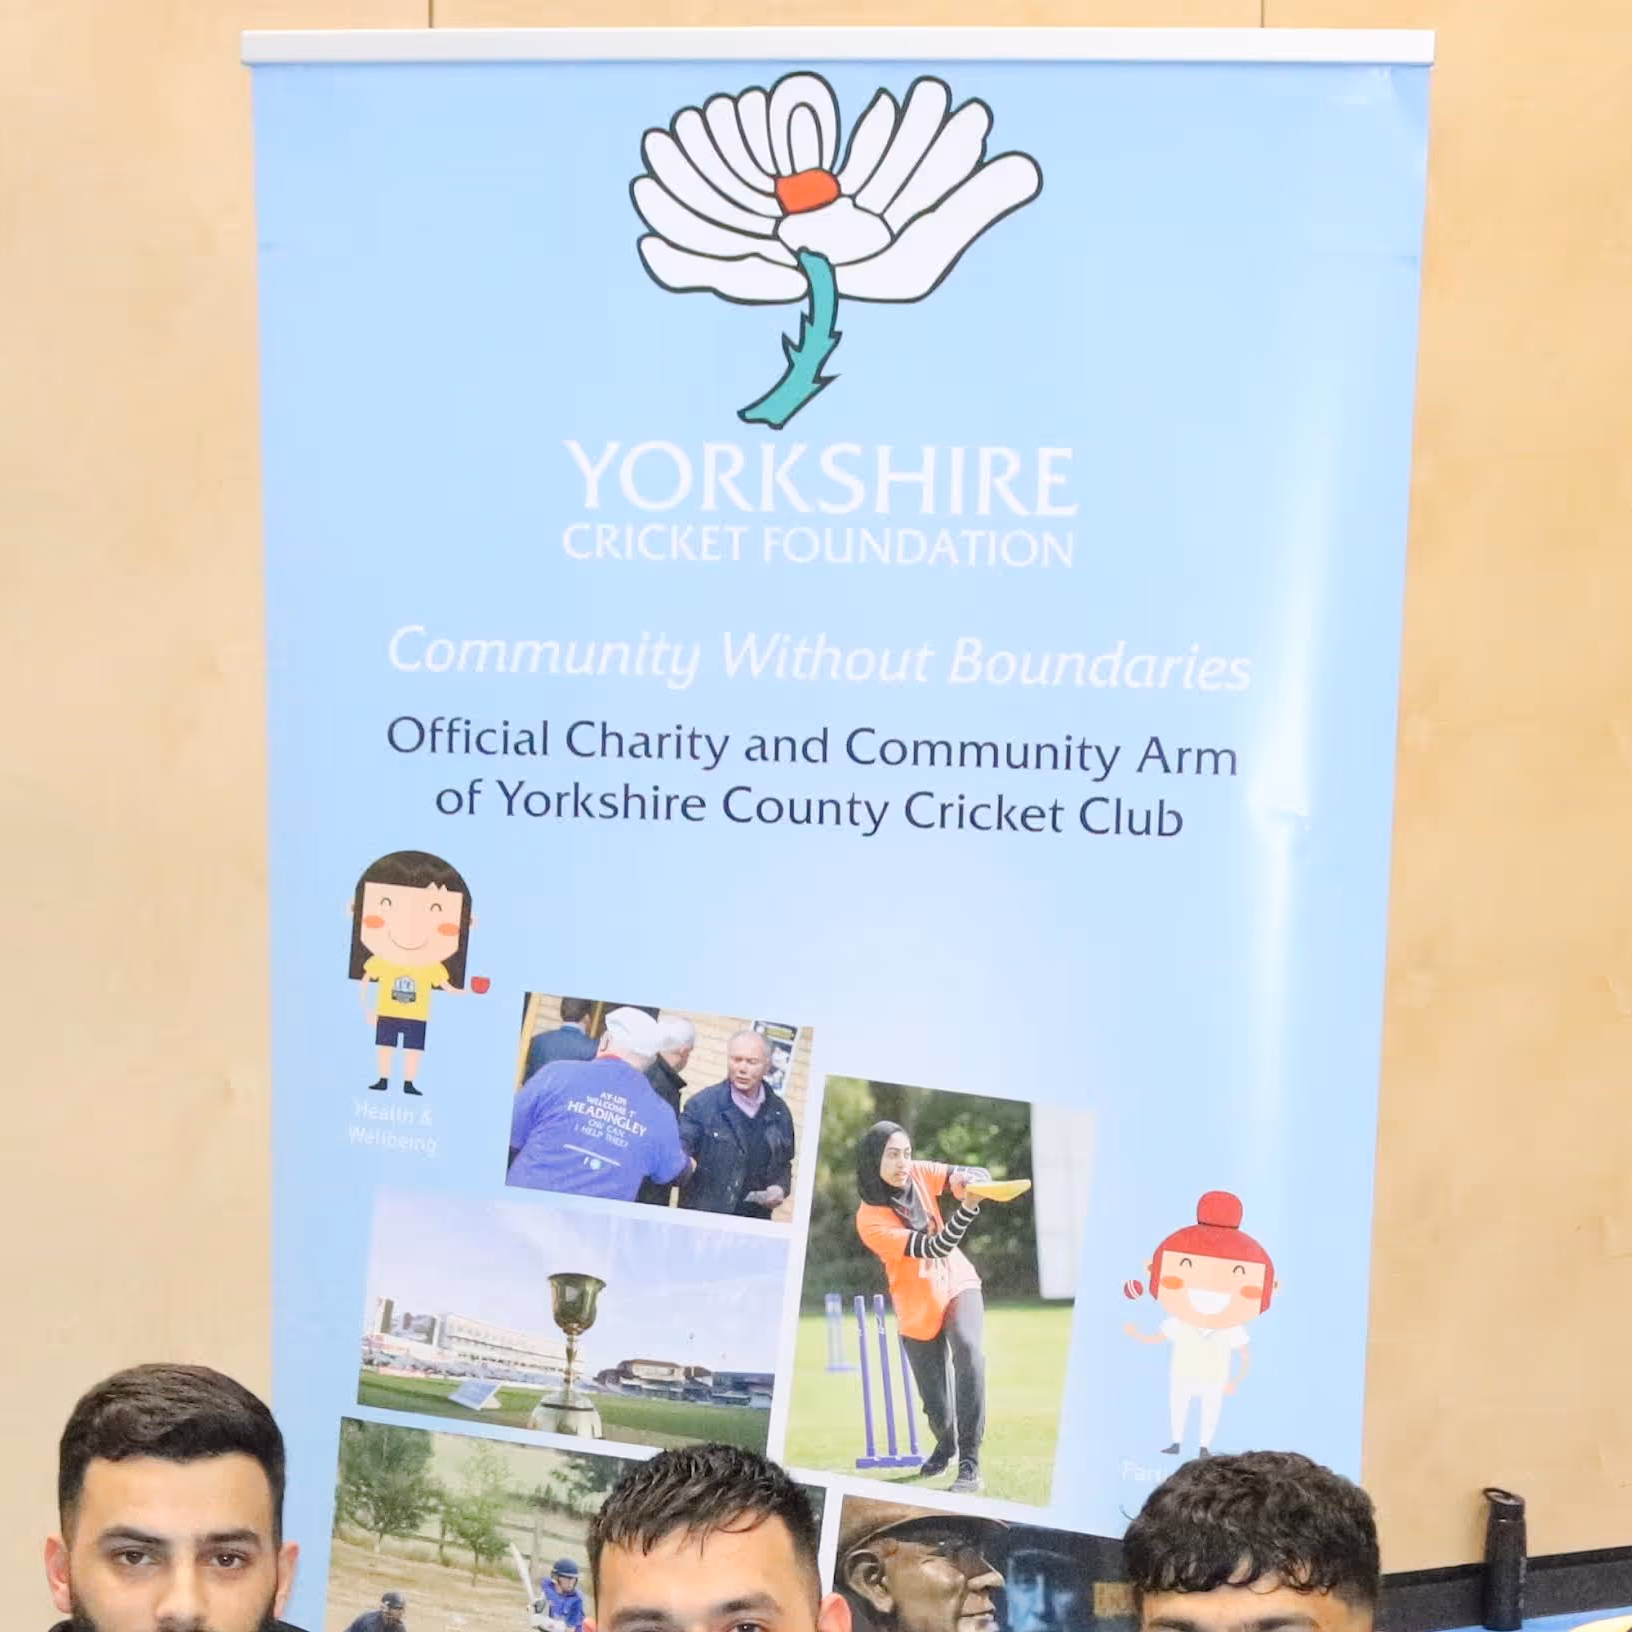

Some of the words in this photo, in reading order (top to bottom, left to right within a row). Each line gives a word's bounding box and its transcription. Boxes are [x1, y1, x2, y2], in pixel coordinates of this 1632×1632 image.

[562, 438, 1080, 517] YORKSHIRE
[561, 522, 749, 562] CRICKET
[763, 526, 1074, 569] FOUNDATION
[387, 623, 702, 692] Community
[723, 630, 936, 684] Without
[946, 636, 1253, 692] Boundaries
[387, 715, 549, 757] Official
[565, 719, 730, 771] Charity
[744, 726, 829, 764] and
[845, 727, 1121, 783] Community
[1136, 735, 1238, 776] Arm
[435, 777, 484, 815] of
[495, 779, 707, 822] Yorkshire
[722, 785, 890, 838] County
[904, 790, 1065, 834] Cricket
[1079, 796, 1184, 837] Club
[567, 1100, 647, 1136] HEADINGLEY
